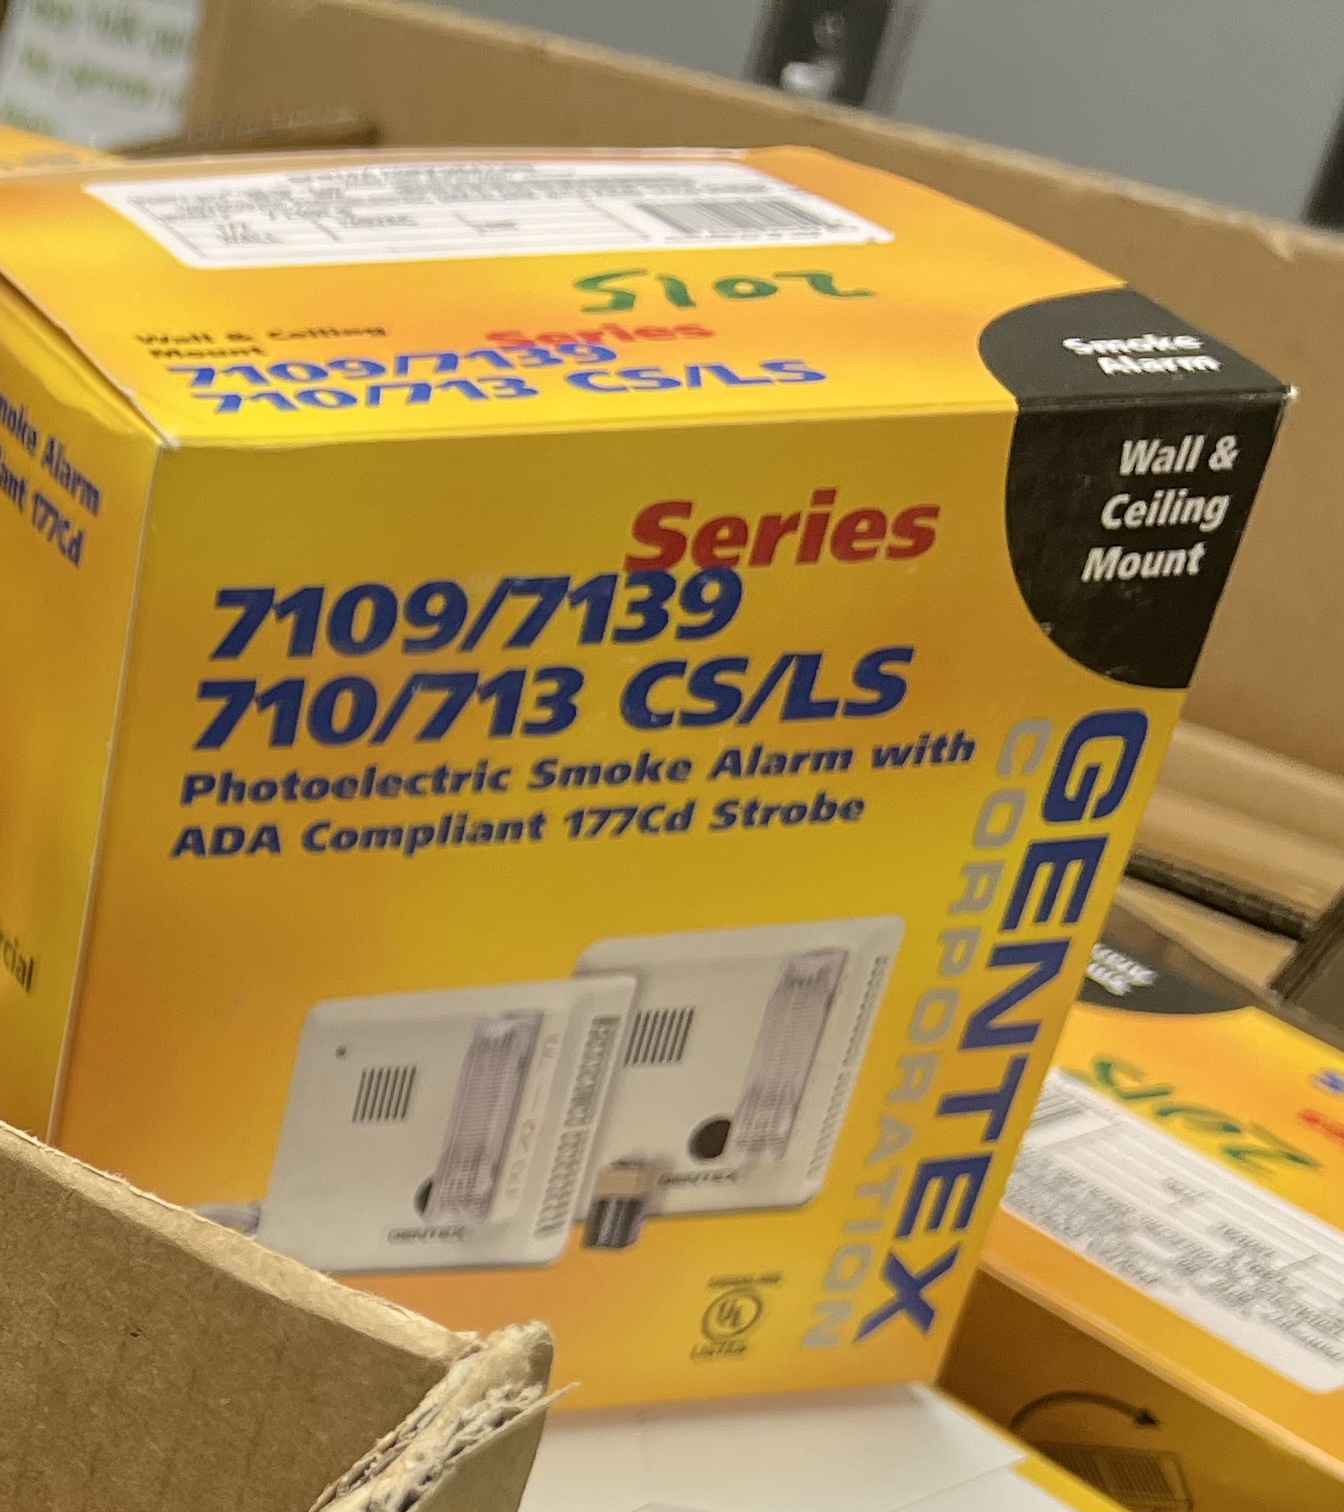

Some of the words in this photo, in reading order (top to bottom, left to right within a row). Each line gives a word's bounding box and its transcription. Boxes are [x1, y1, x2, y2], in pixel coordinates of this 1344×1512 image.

[484, 323, 717, 349] Series
[1062, 334, 1205, 356] Smoke
[165, 342, 618, 390] 7109/7139
[192, 376, 540, 415] 710/713
[563, 360, 827, 394] CS/LS
[1096, 355, 1222, 376] Alarm
[1119, 435, 1205, 475] Wall
[1208, 435, 1239, 471] &
[624, 487, 940, 572] Series
[1100, 488, 1233, 533] Ceiling
[1081, 541, 1208, 583] Mount
[209, 566, 744, 660] 7109/7139
[192, 667, 585, 751] 710/713
[621, 647, 914, 729] CS/LS
[179, 760, 511, 805] Photoelectric
[527, 752, 693, 793] Smoke
[712, 743, 853, 780] Alarm
[872, 732, 975, 768] with
[171, 825, 281, 859] ADA
[302, 811, 545, 856] Compliant
[563, 799, 694, 838] 177Cd
[709, 793, 865, 830] Strobe
[801, 718, 1054, 1350] CORPORATION
[853, 709, 1149, 1343] GENTEX
